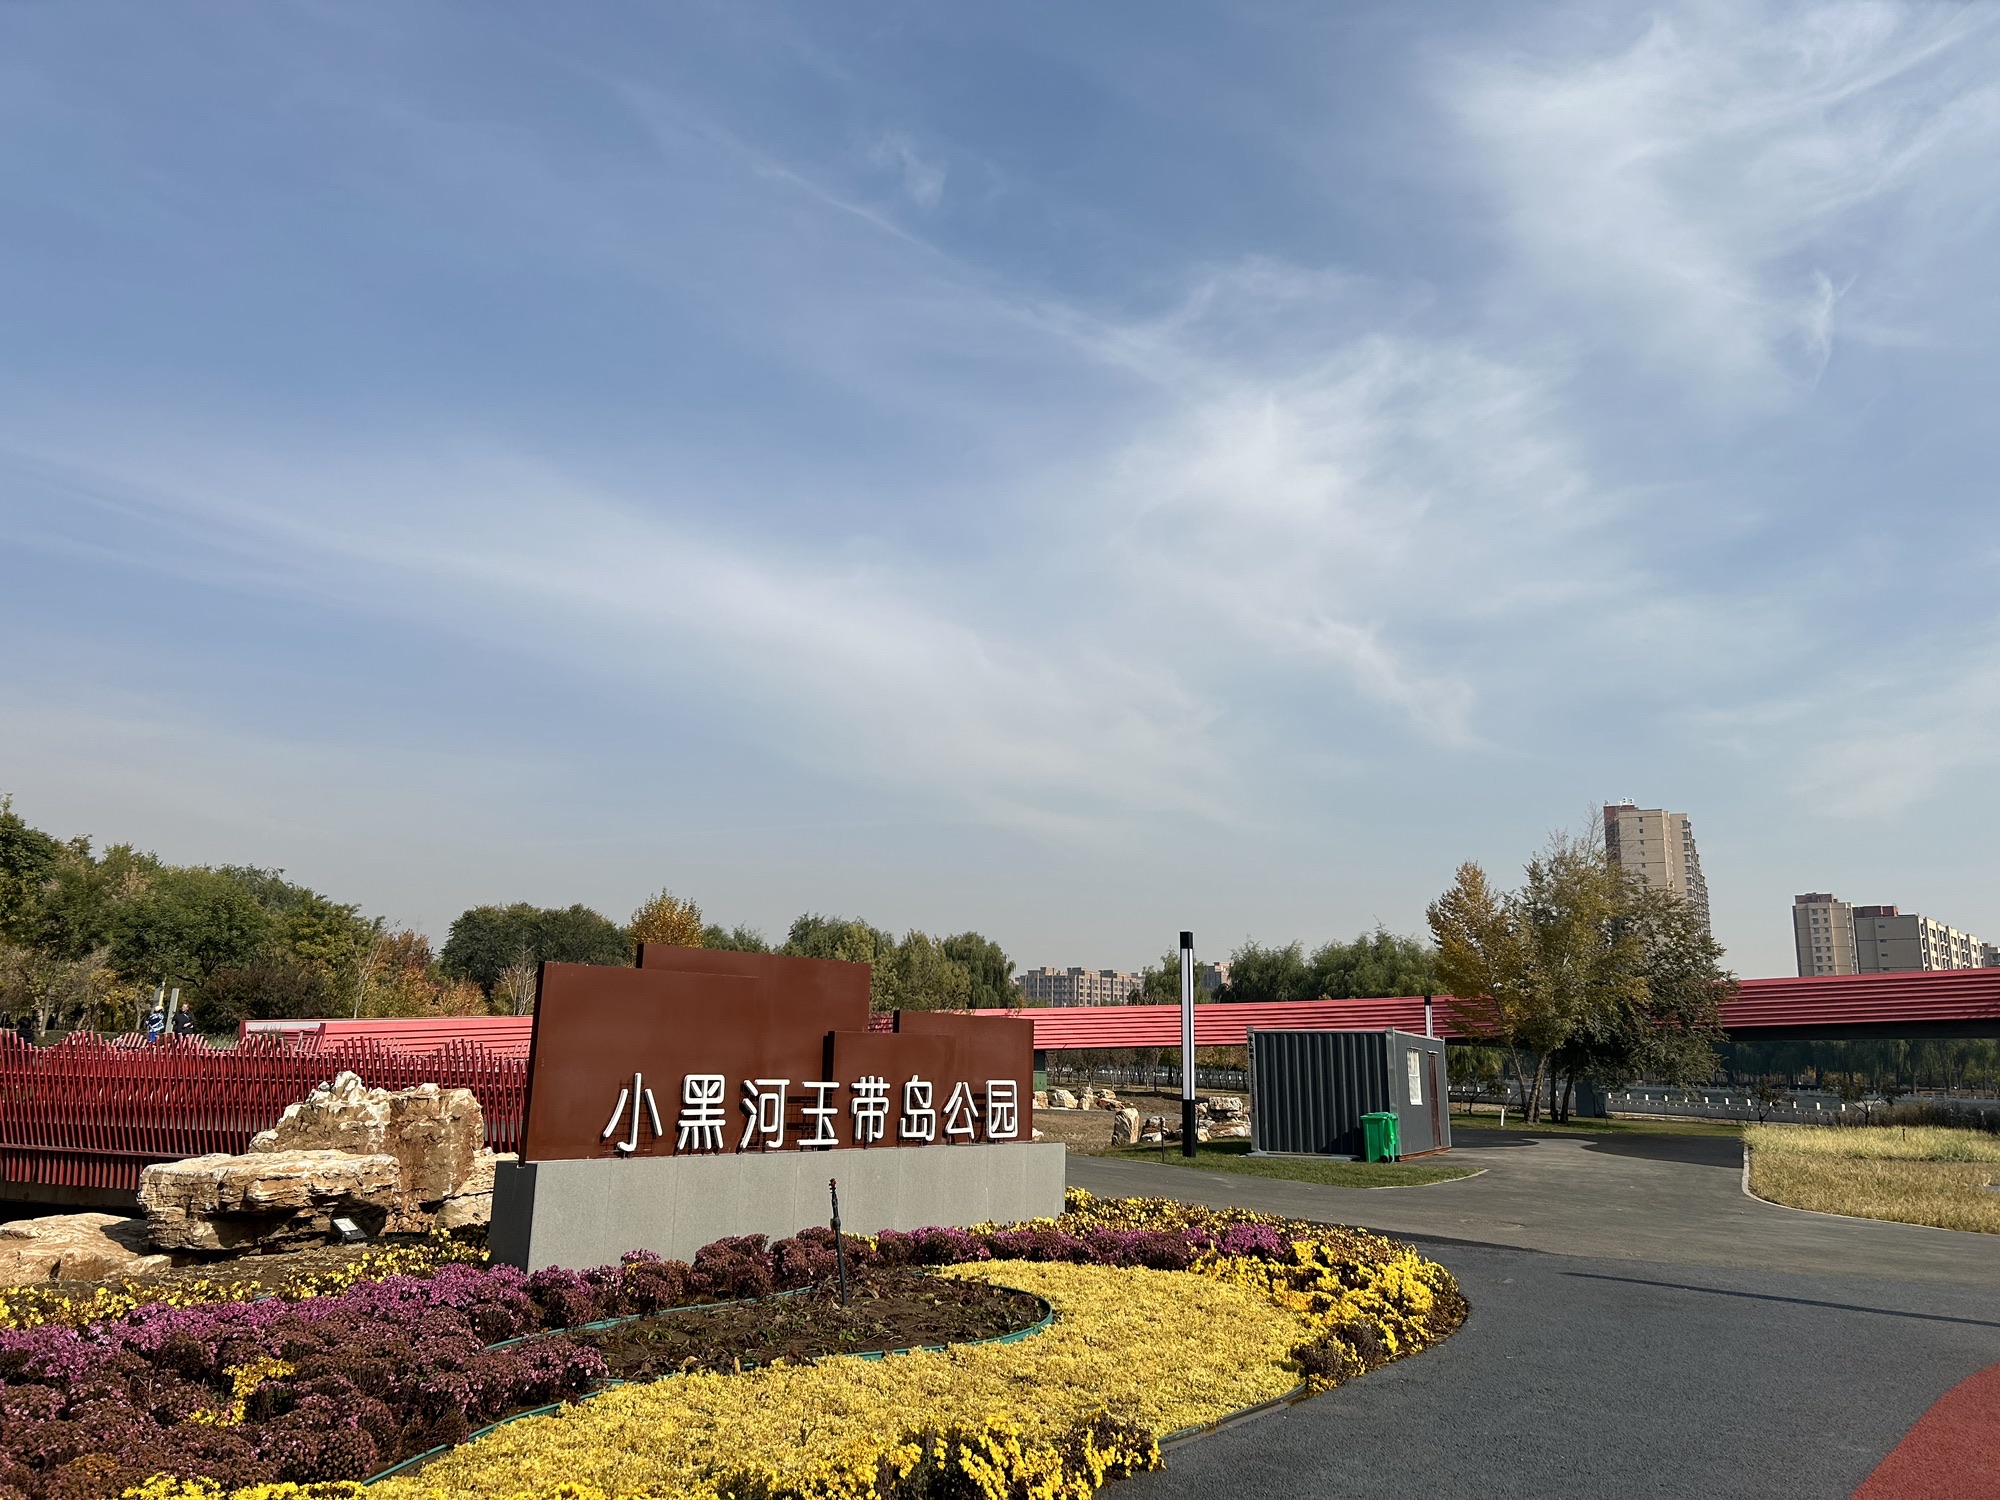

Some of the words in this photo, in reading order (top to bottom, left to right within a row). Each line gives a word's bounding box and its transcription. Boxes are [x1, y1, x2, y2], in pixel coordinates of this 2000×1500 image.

[603, 1072, 1017, 1152] 小黑河玉带岛公园
